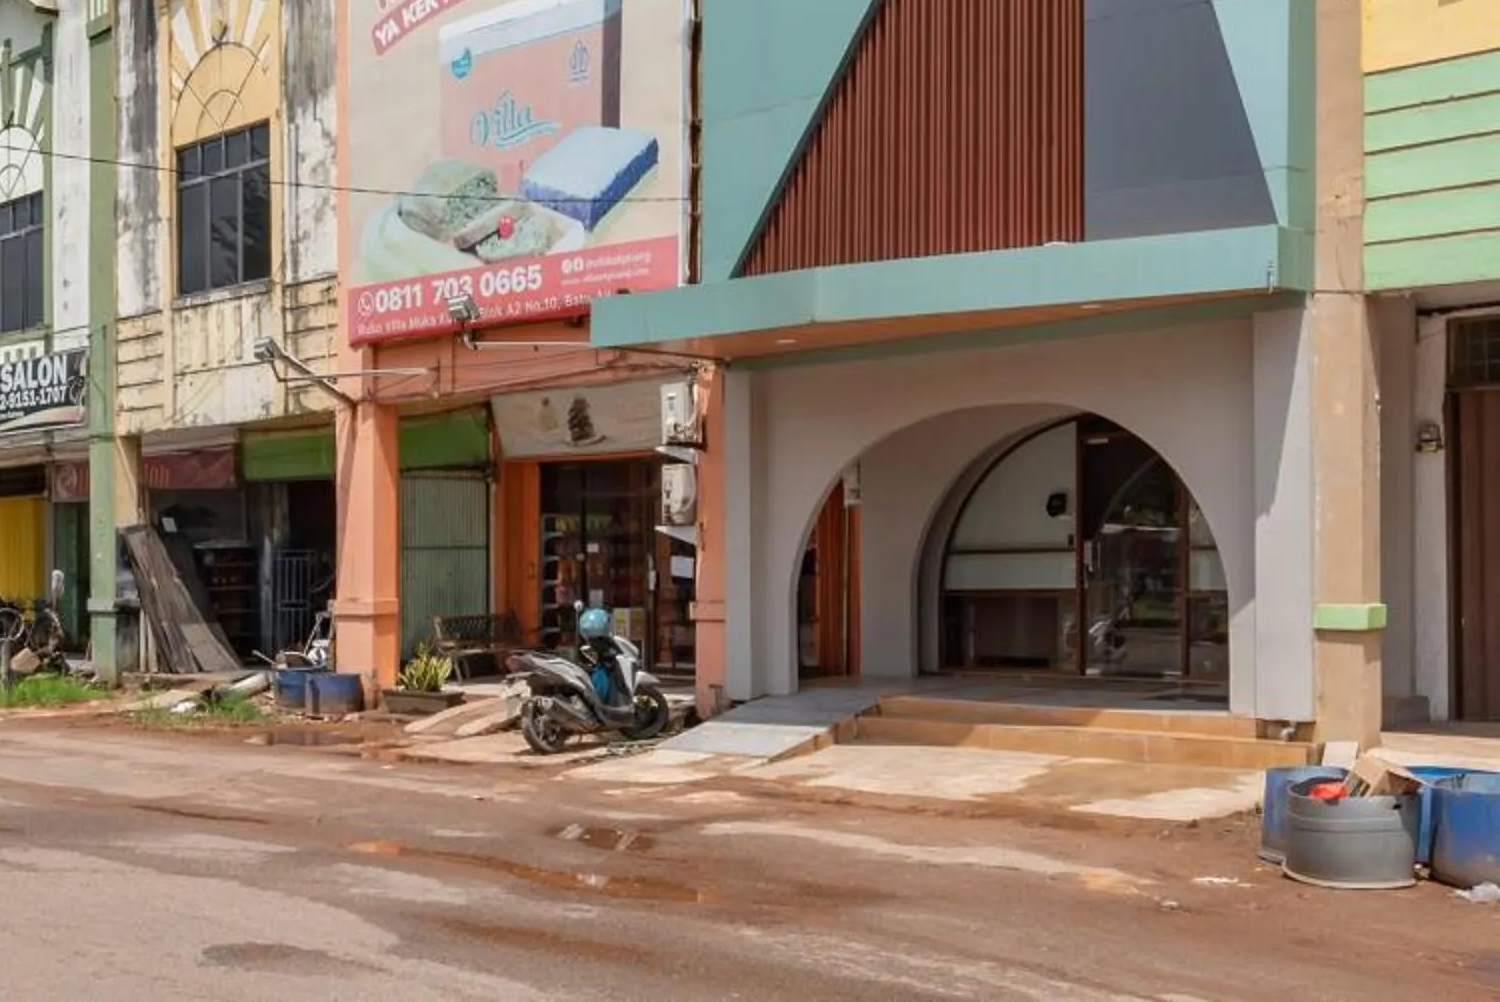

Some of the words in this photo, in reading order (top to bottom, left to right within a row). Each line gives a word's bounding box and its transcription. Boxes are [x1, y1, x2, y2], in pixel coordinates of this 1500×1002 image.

[374, 18, 399, 47] YA
[375, 283, 422, 313] 0811
[431, 275, 473, 305] 703
[479, 264, 542, 297] 0665
[0, 353, 68, 393] SALON
